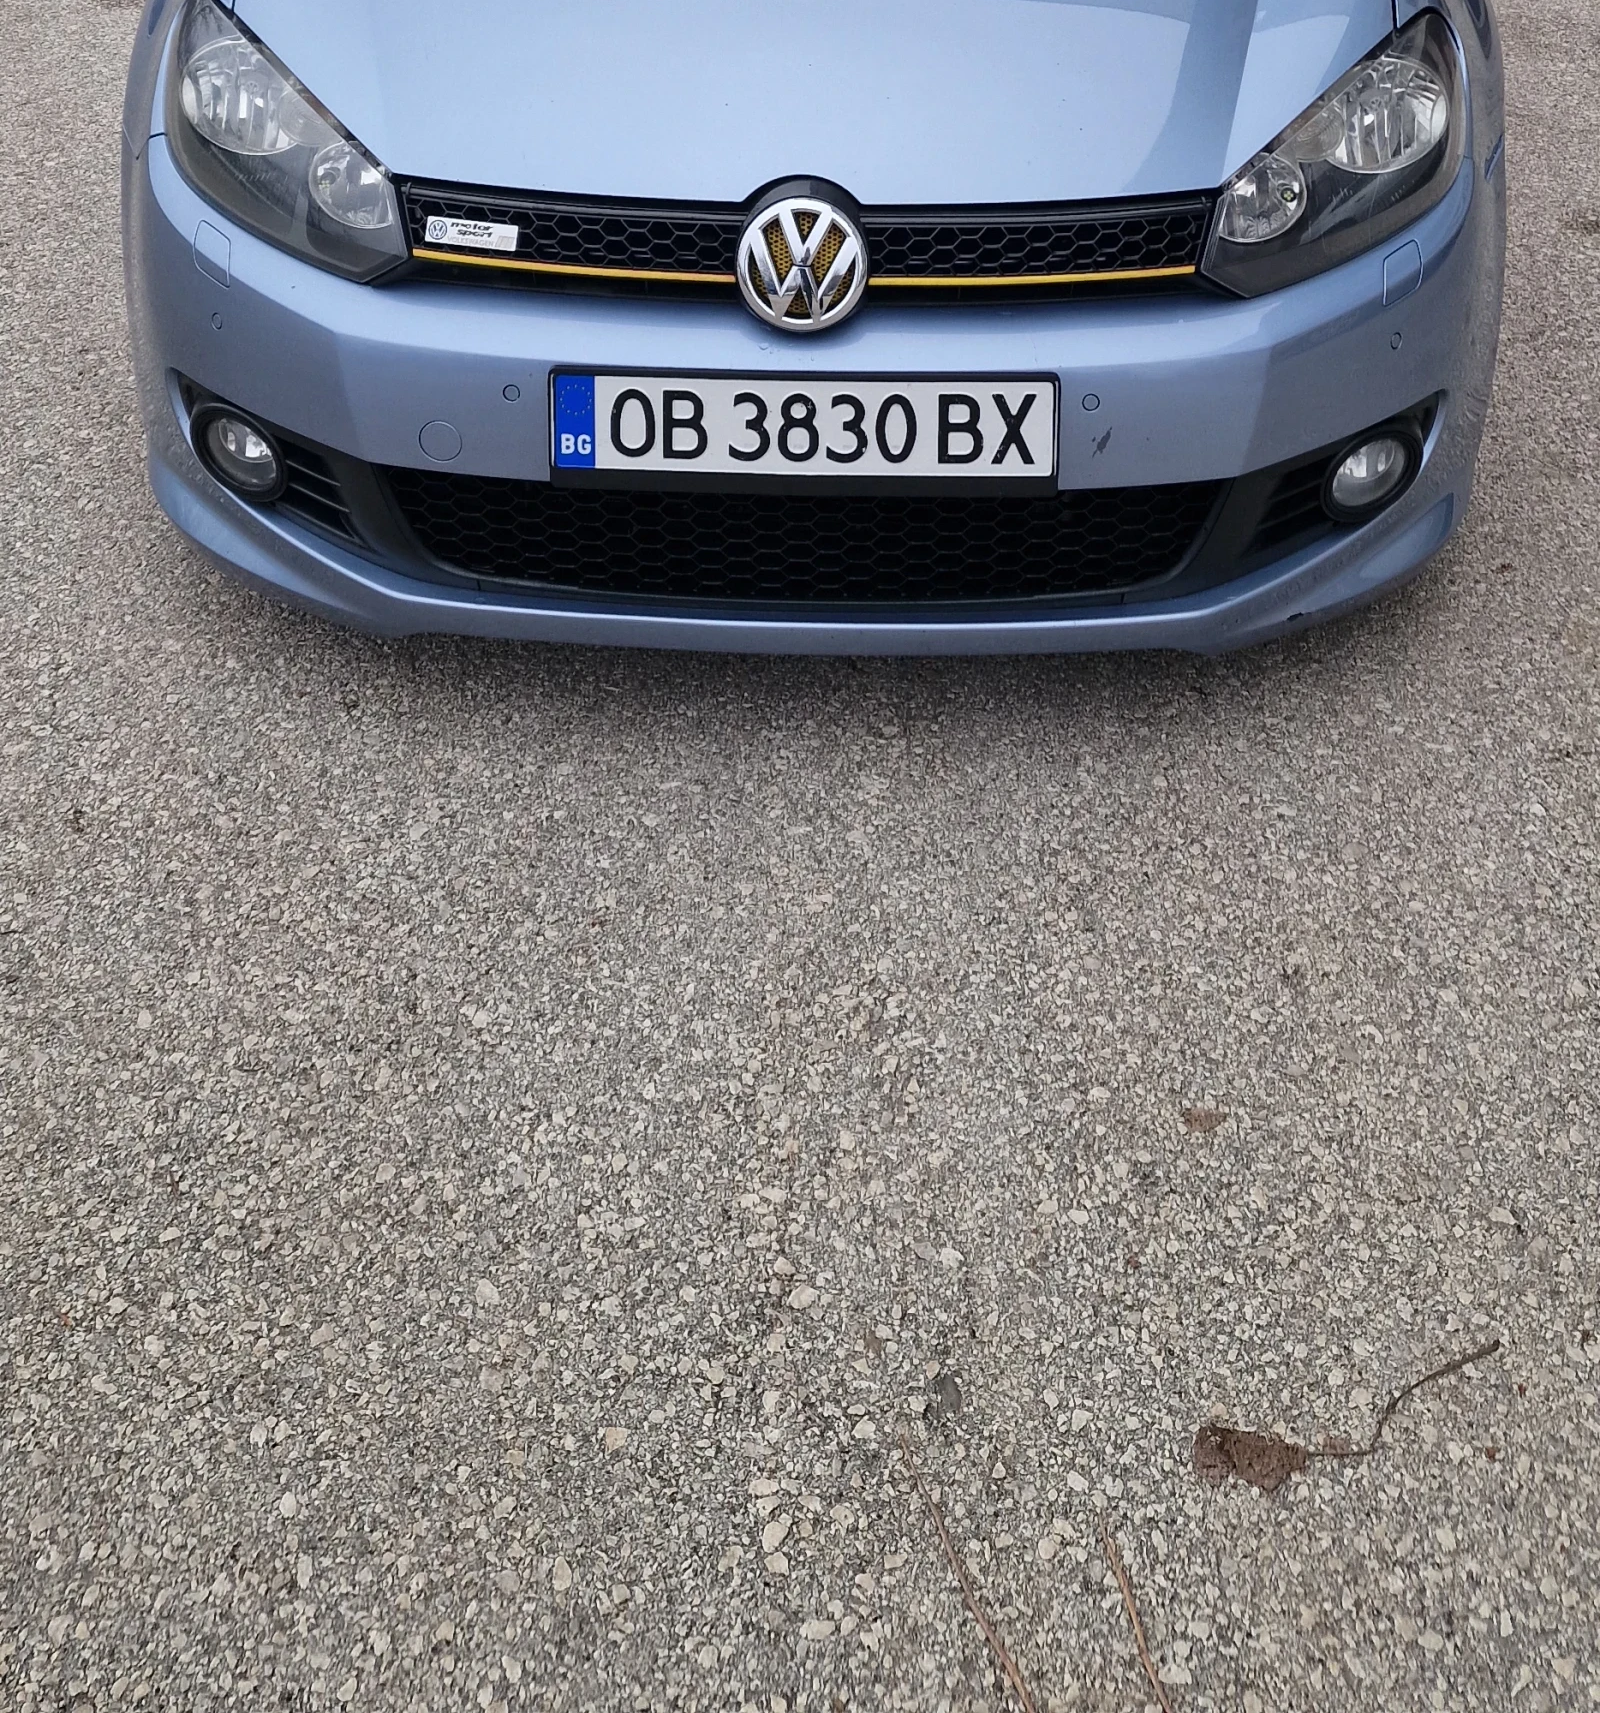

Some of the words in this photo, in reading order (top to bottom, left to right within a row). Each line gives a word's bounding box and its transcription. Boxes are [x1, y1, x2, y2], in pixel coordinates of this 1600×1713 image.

[450, 221, 494, 231] motor
[456, 229, 493, 238] sport
[446, 236, 495, 248] VOLKSWAGEN
[610, 388, 708, 460] OB
[727, 391, 917, 464] 3830
[937, 392, 1037, 465] BX
[560, 432, 592, 455] BG
